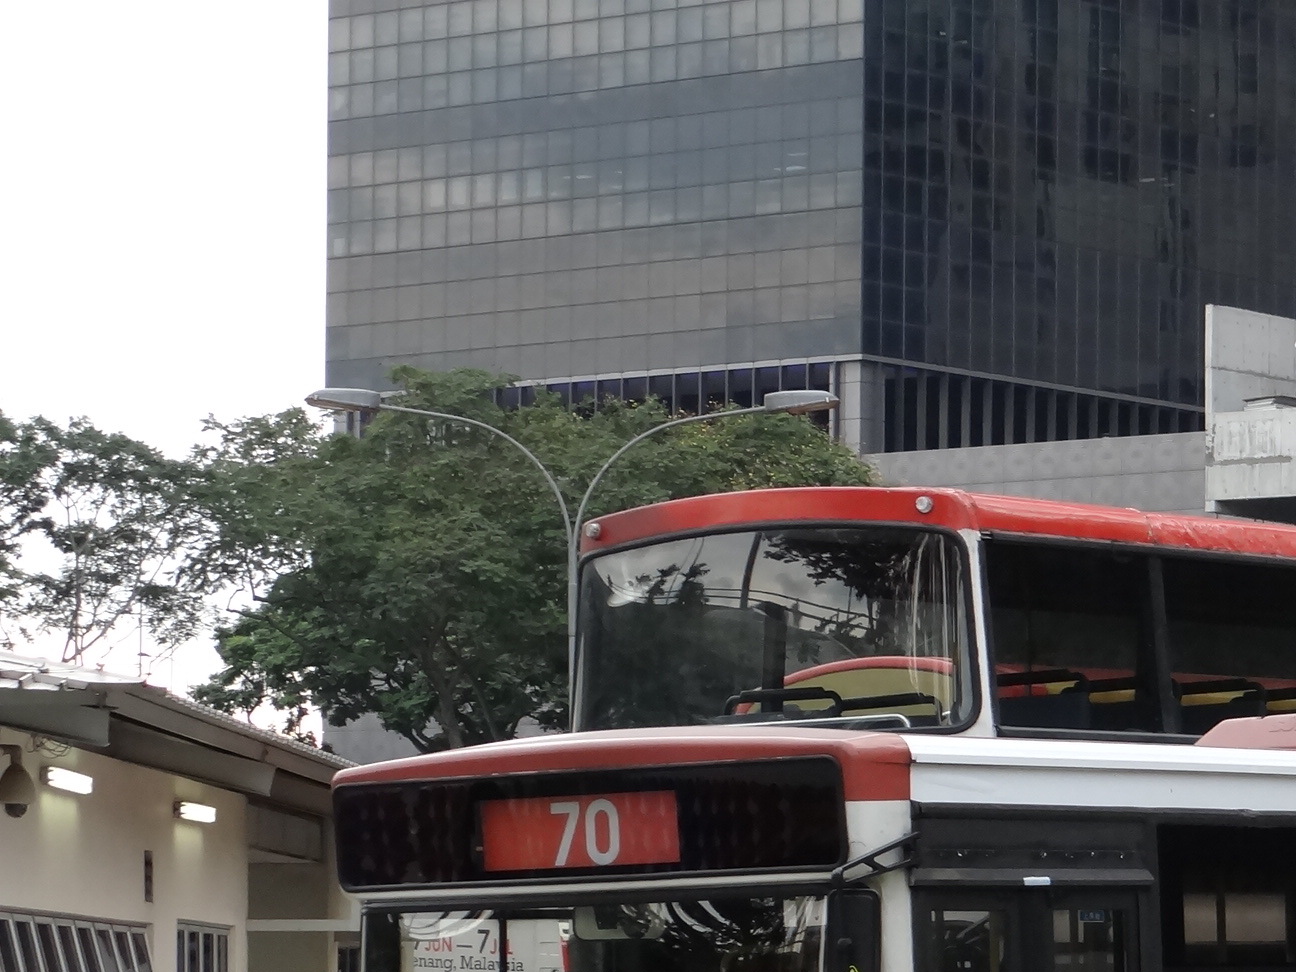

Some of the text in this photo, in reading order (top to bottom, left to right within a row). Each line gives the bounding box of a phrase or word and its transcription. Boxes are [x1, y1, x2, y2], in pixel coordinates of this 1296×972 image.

[550, 799, 620, 867] 70
[477, 929, 491, 954] 7
[490, 938, 513, 955] JL
